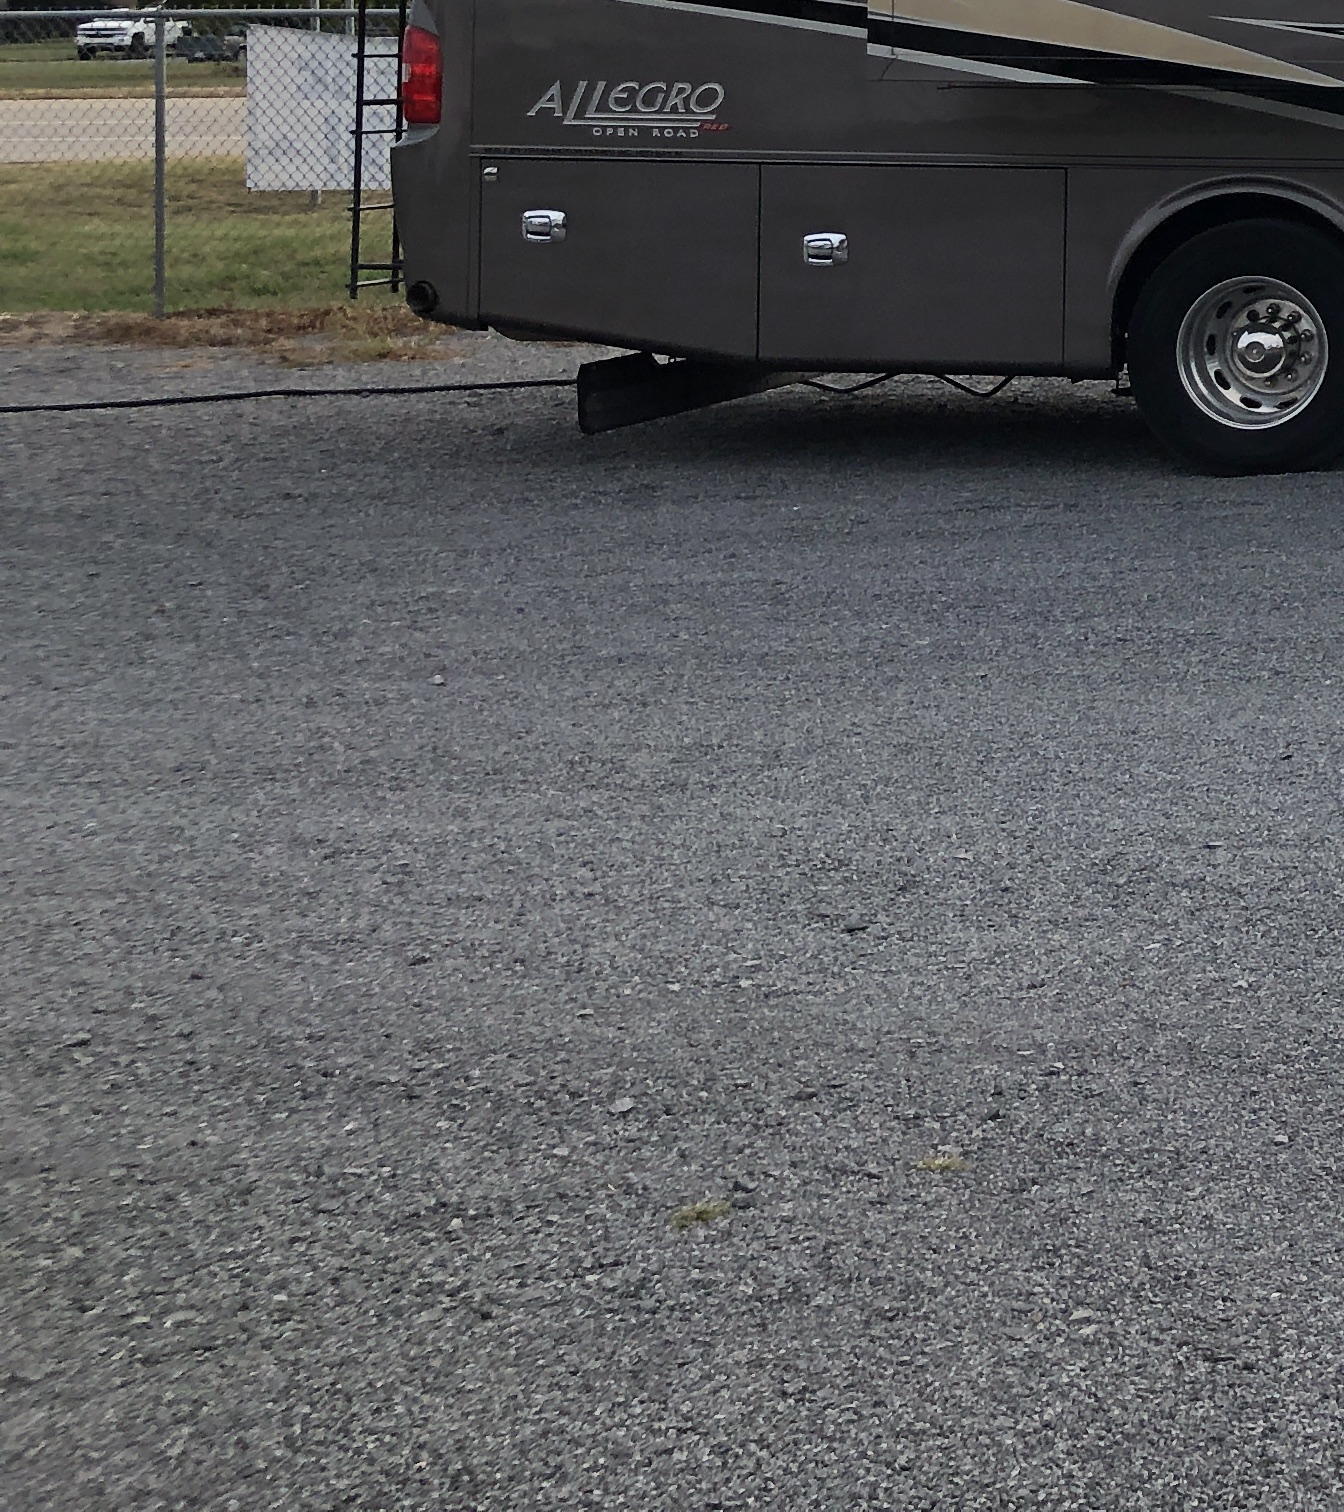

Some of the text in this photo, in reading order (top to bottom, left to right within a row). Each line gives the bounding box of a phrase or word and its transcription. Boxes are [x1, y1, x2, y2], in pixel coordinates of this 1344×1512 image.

[526, 79, 725, 126] ALLEGRO
[592, 127, 700, 138] OPEN ROAD
